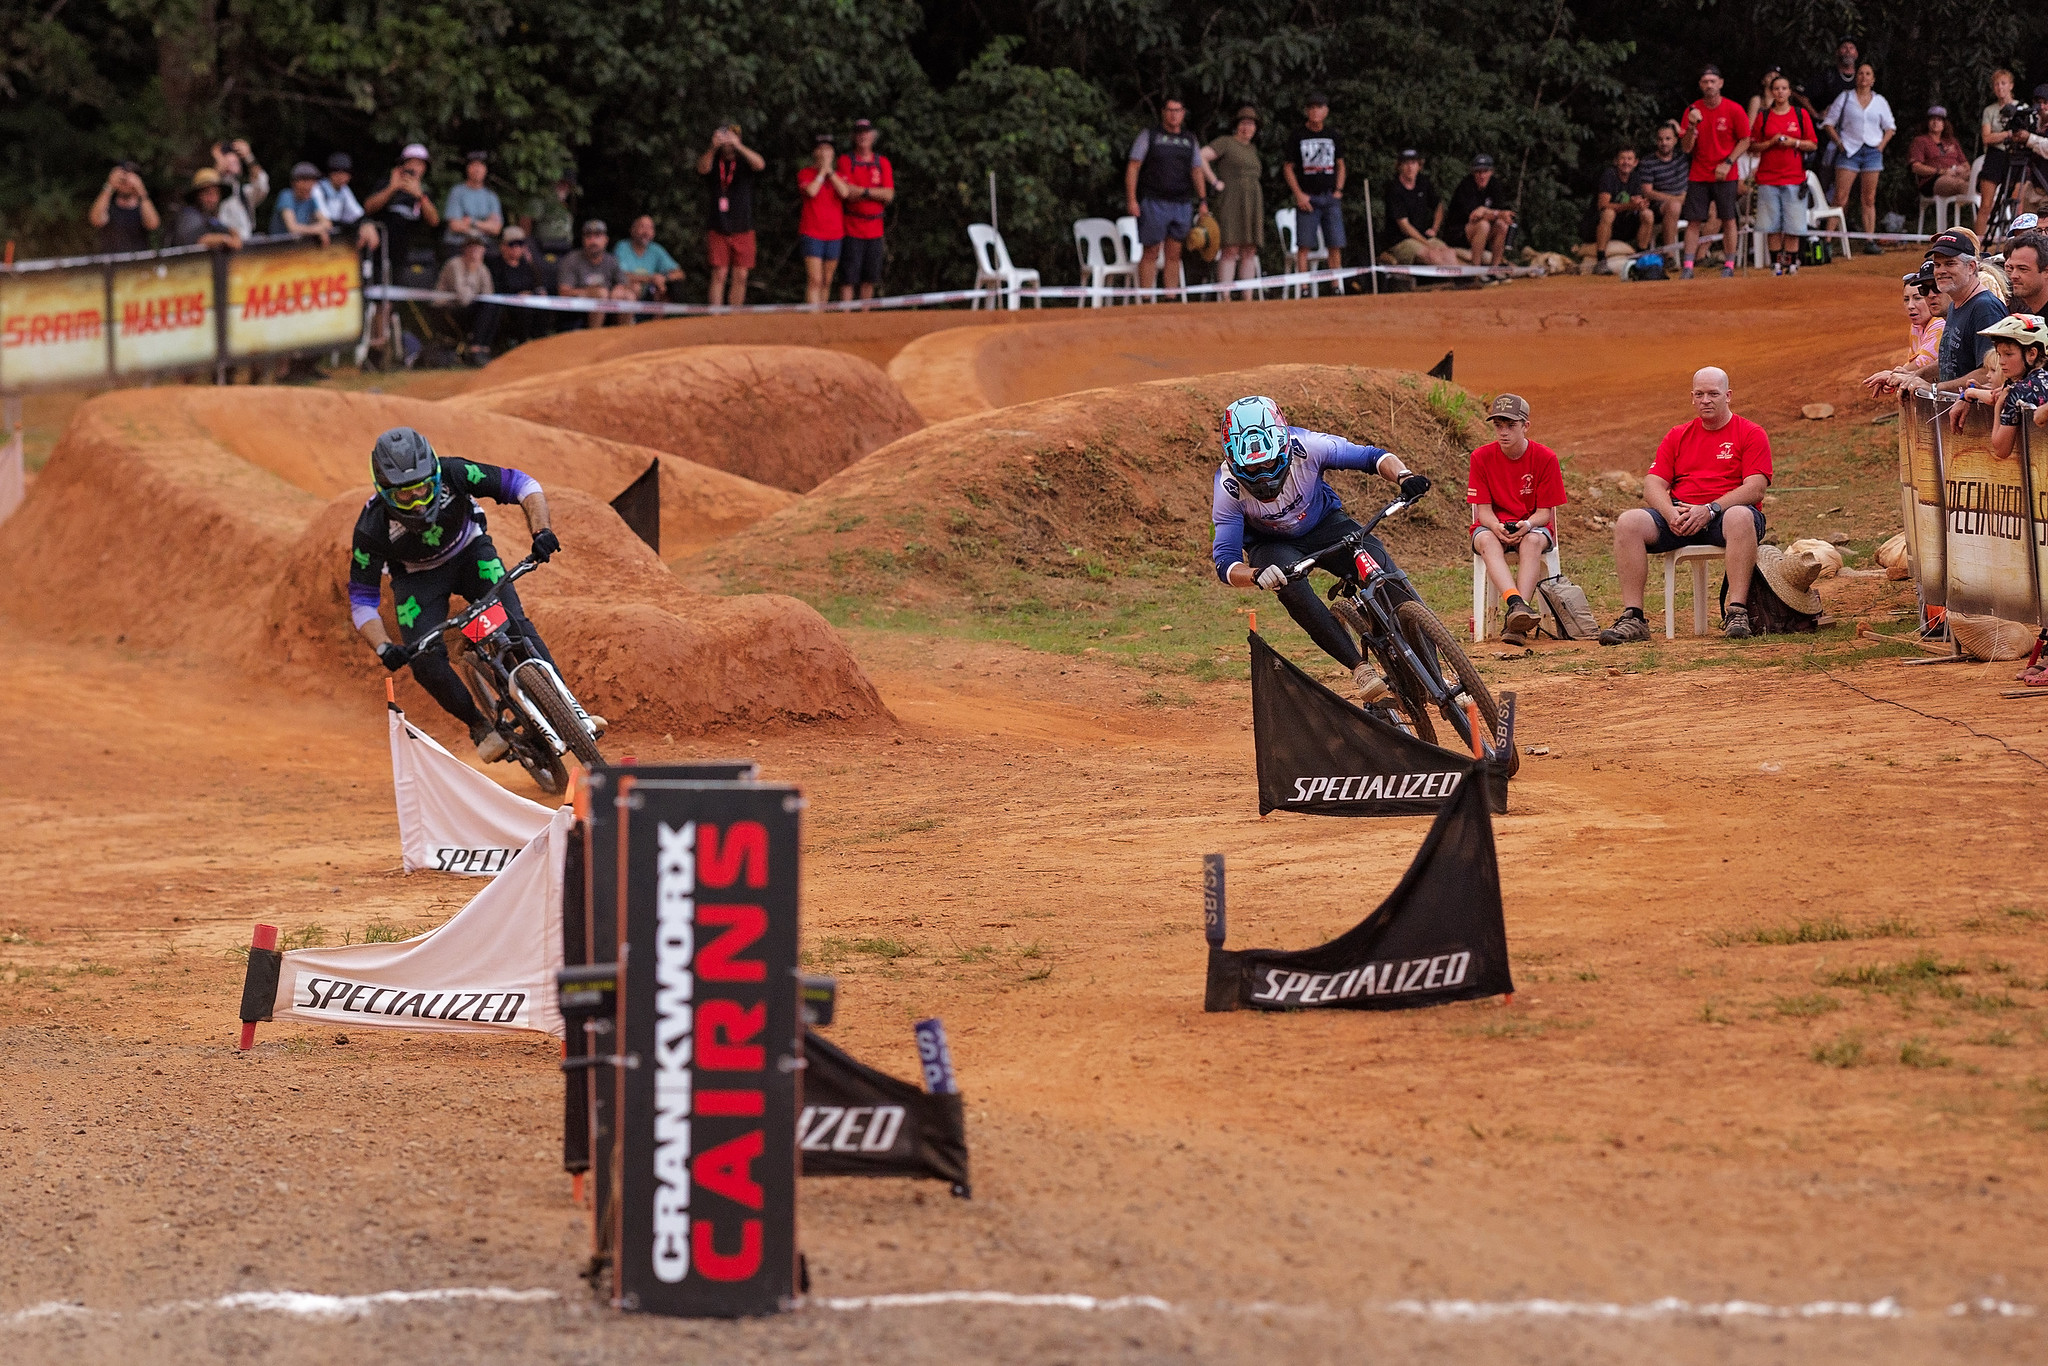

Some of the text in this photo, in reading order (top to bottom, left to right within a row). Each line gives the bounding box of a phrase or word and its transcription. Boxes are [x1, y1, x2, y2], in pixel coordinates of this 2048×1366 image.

[121, 292, 207, 336] MAXXIS
[242, 273, 349, 321] MAXXIS
[1, 308, 102, 349] SRAM
[1946, 480, 2022, 540] PECIALIZED
[479, 614, 492, 629] 3
[1496, 697, 1510, 749] SB/SX
[1287, 771, 1463, 802] SPECIALIZED
[296, 977, 527, 1023] SPECIALIZED
[1254, 950, 1471, 1003] SPECIALIZED
[652, 819, 696, 1283] CRANKWORX
[692, 820, 768, 1282] CAIRNS
